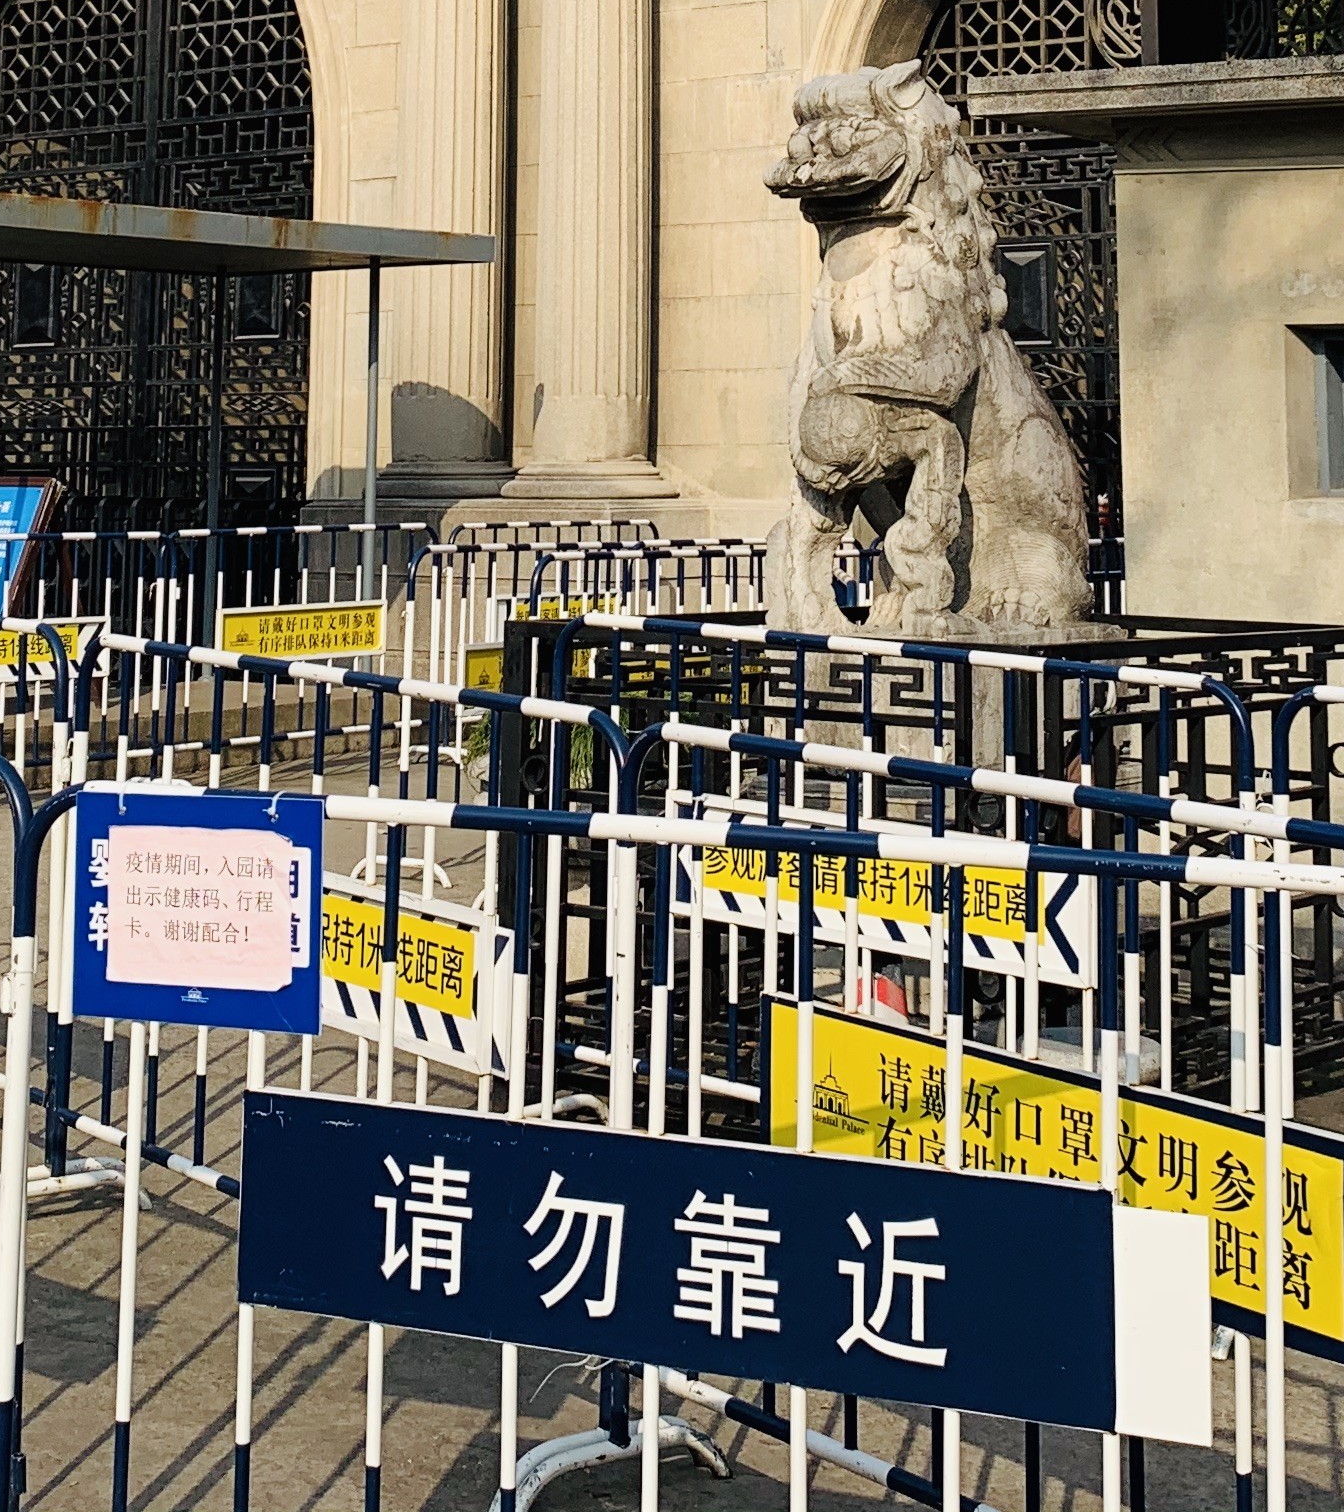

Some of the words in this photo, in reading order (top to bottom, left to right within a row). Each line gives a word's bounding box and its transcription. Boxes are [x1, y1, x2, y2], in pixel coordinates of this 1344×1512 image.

[259, 612, 376, 634] 请戴好口罩文明参观
[258, 630, 375, 653] 有序排队保持1米距离
[126, 886, 274, 913] 出示健康码、行程
[374, 1154, 949, 1367] 请勿靠近
